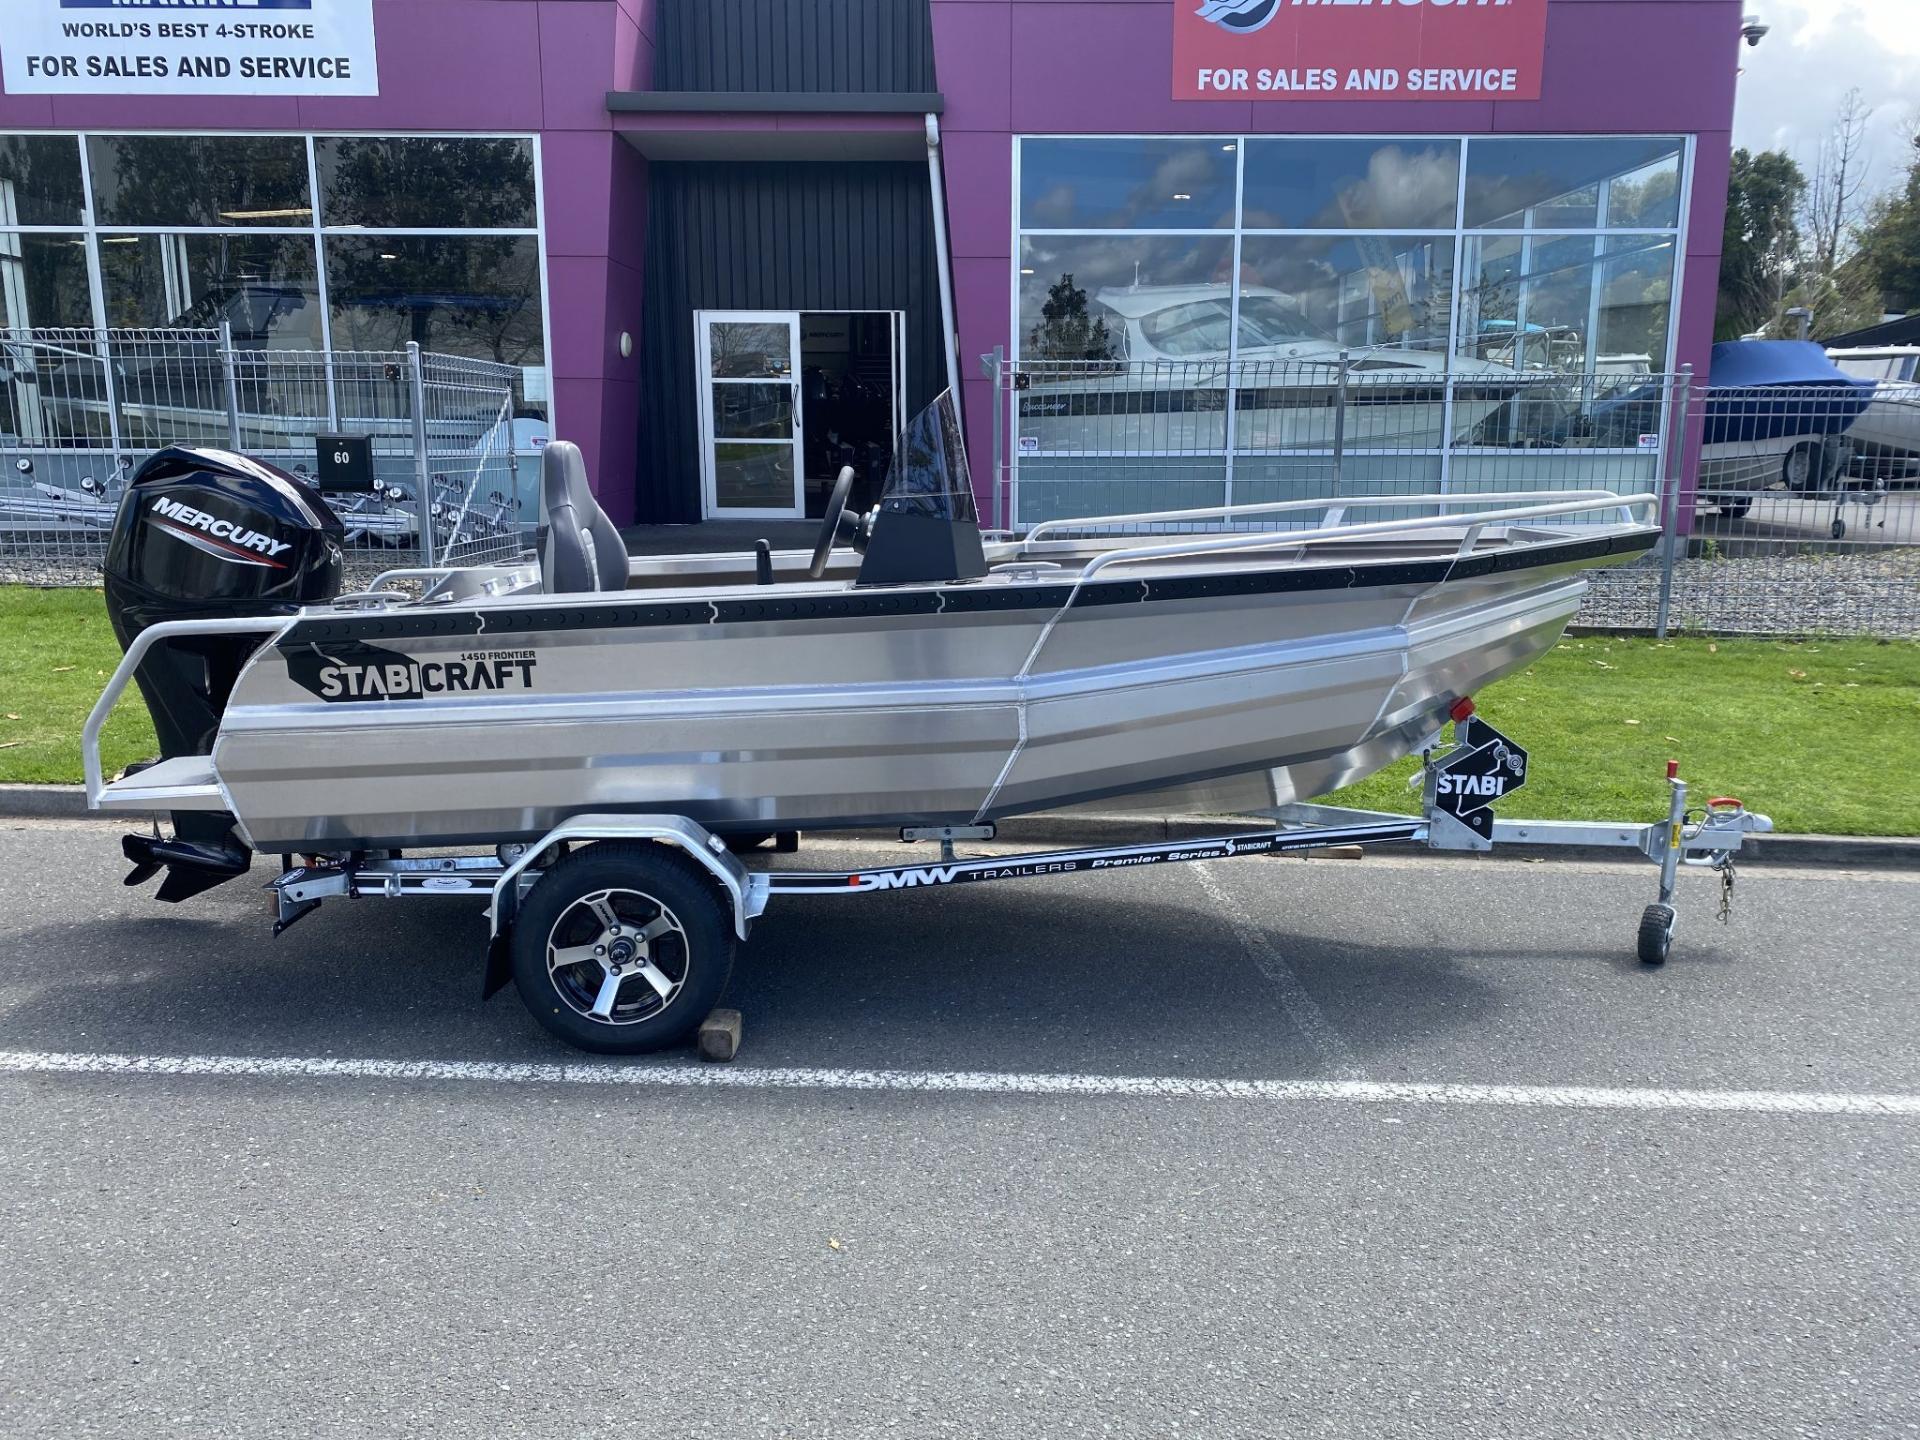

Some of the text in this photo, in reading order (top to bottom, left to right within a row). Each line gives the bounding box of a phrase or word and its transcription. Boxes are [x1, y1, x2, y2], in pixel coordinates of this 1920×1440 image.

[62, 23, 315, 40] WORLD'S BEST 4-STROKE
[26, 55, 351, 79] FOR SALES AND SERVICE
[1197, 69, 1518, 91] FOR SALES AND SERVICE
[334, 451, 350, 464] 60
[151, 496, 292, 557] MERCURY
[460, 650, 536, 661] 1450 FRONTIER
[319, 659, 537, 697] STABICRAFT
[1437, 773, 1504, 796] STABI
[968, 862, 1077, 881] TRAILERS
[1092, 855, 1161, 868] Premier
